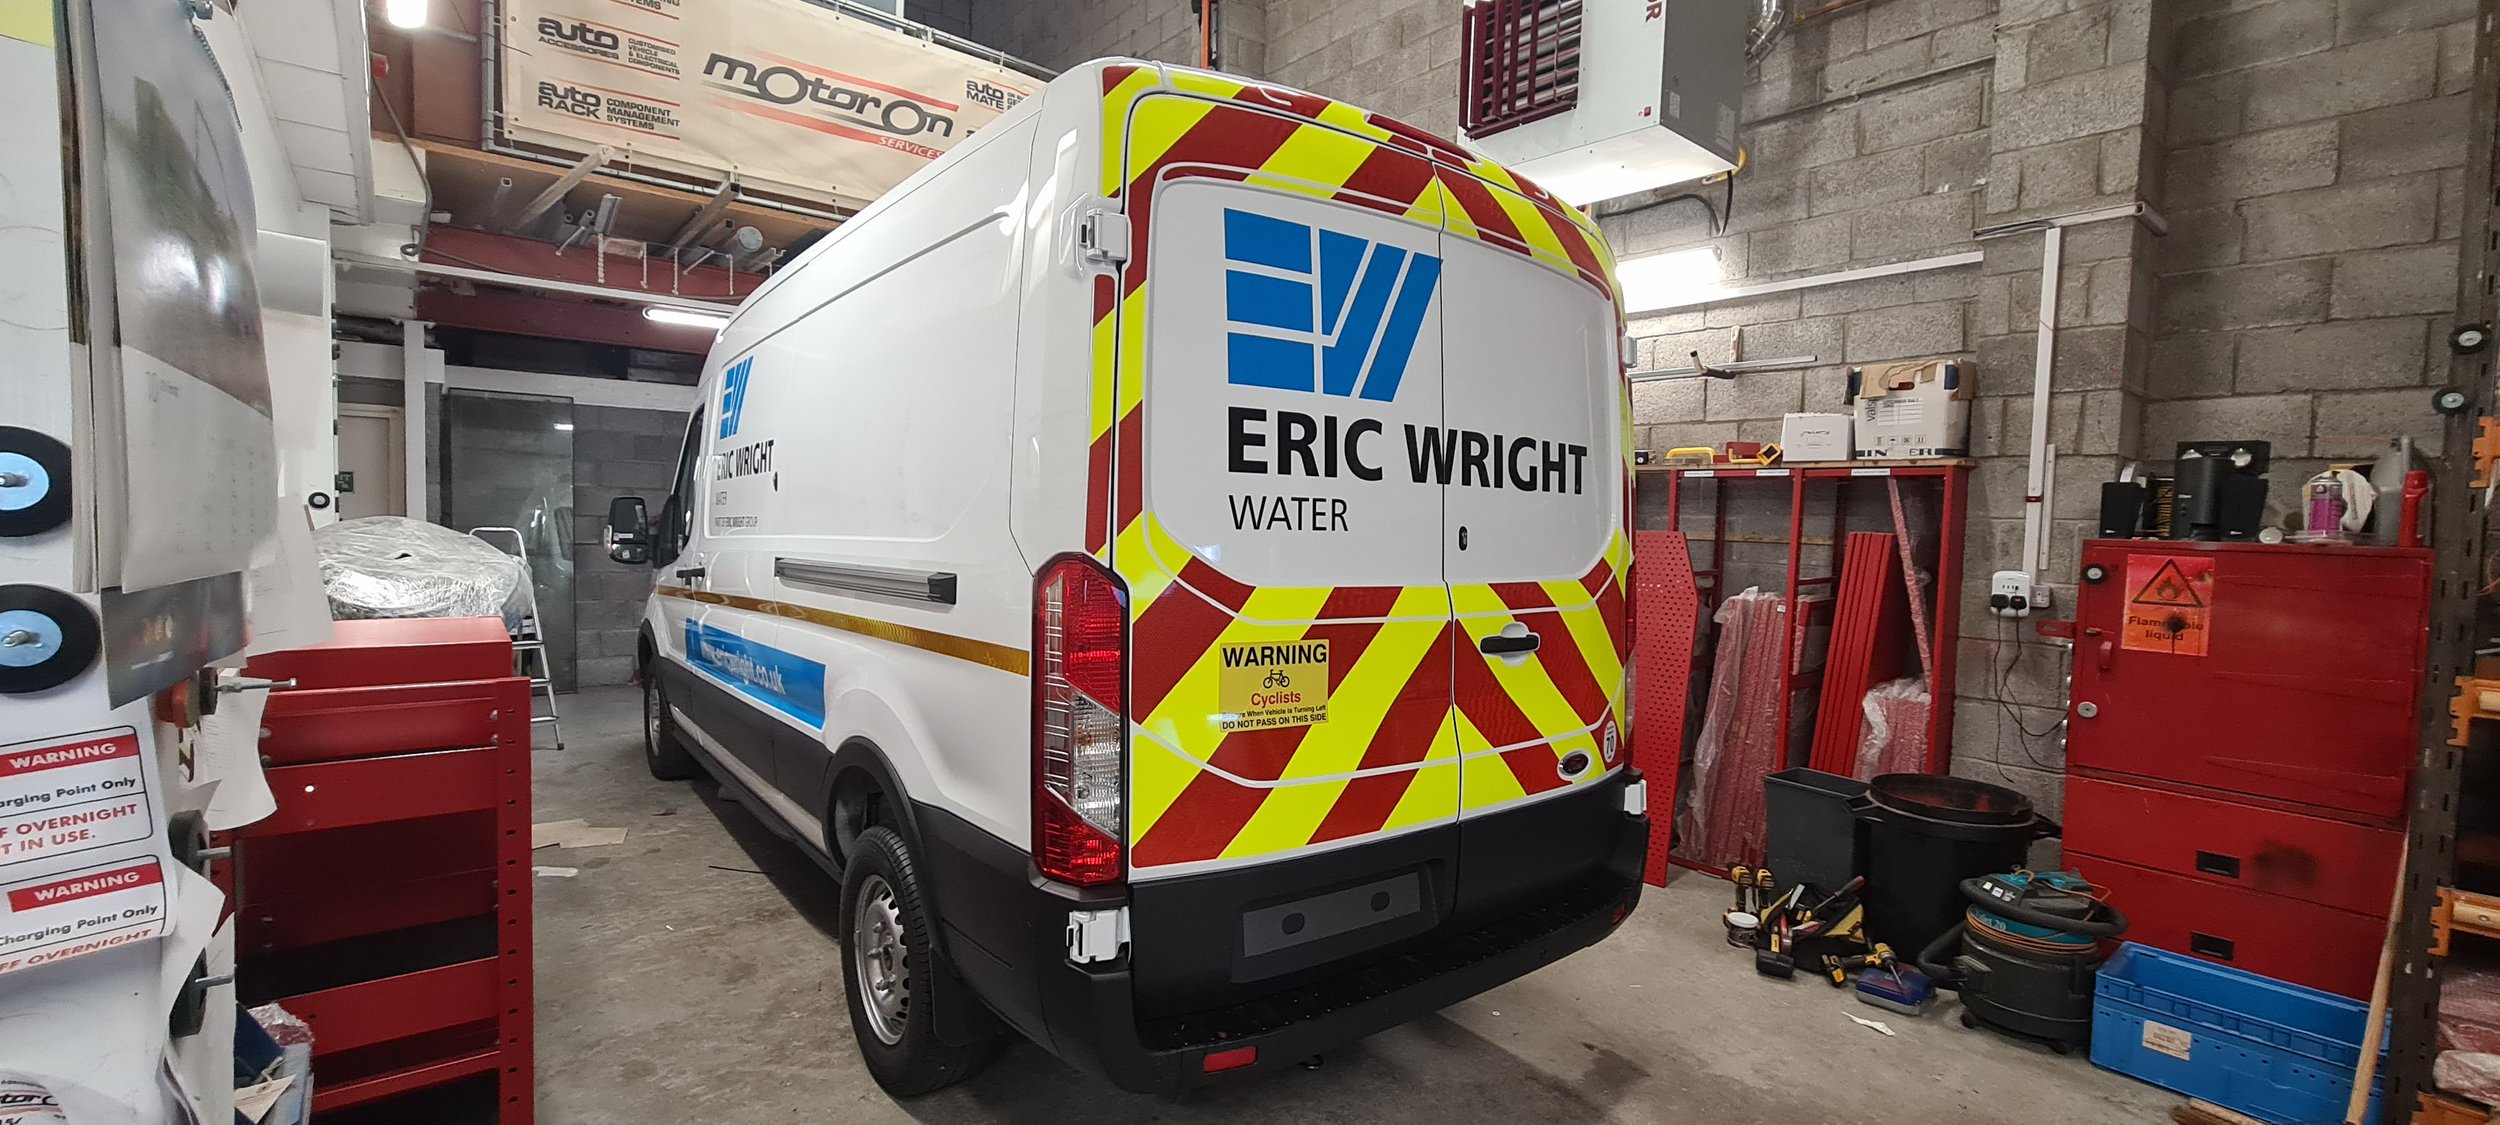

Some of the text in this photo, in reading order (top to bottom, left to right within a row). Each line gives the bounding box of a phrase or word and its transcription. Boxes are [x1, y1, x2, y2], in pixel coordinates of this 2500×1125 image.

[538, 17, 619, 50] auto
[538, 36, 620, 60] ACCESSORIES
[628, 37, 676, 55] CUSTOMISED
[628, 44, 658, 57] VEHICLE
[628, 57, 681, 75] COMPONENTS
[636, 53, 679, 68] ELECTRICAL
[538, 81, 601, 107] auto
[966, 80, 1005, 100] auto
[966, 91, 1005, 110] MATE
[538, 95, 601, 120] RACK
[606, 98, 671, 117] COMPONENT
[606, 107, 681, 127] MANAGEMENT
[606, 115, 655, 130] SYSTEMS
[878, 136, 945, 160] SERVICES
[736, 439, 774, 478] WRIGHT
[1228, 406, 1588, 496] ERIC WRIGHT
[1228, 494, 1349, 532] WATER
[1222, 643, 1327, 668] WARNING
[1247, 710, 1265, 718] When
[1265, 708, 1286, 716] Vehicle
[1294, 705, 1315, 714] Turning
[1316, 704, 1326, 712] Left
[1251, 691, 1302, 709] Cyclists
[1222, 712, 1327, 730] DO NOT PASS ON THIS SIDE
[9, 743, 117, 769] WARNING
[56, 784, 97, 798] Point
[101, 777, 136, 790] Only
[16, 803, 138, 835] OVERNIGHT
[20, 838, 44, 852] IN
[52, 829, 96, 846] USE.
[34, 871, 141, 901] WARNING
[77, 913, 118, 929] Point
[122, 905, 158, 919] Only
[28, 928, 152, 965] OVERNIGHT
